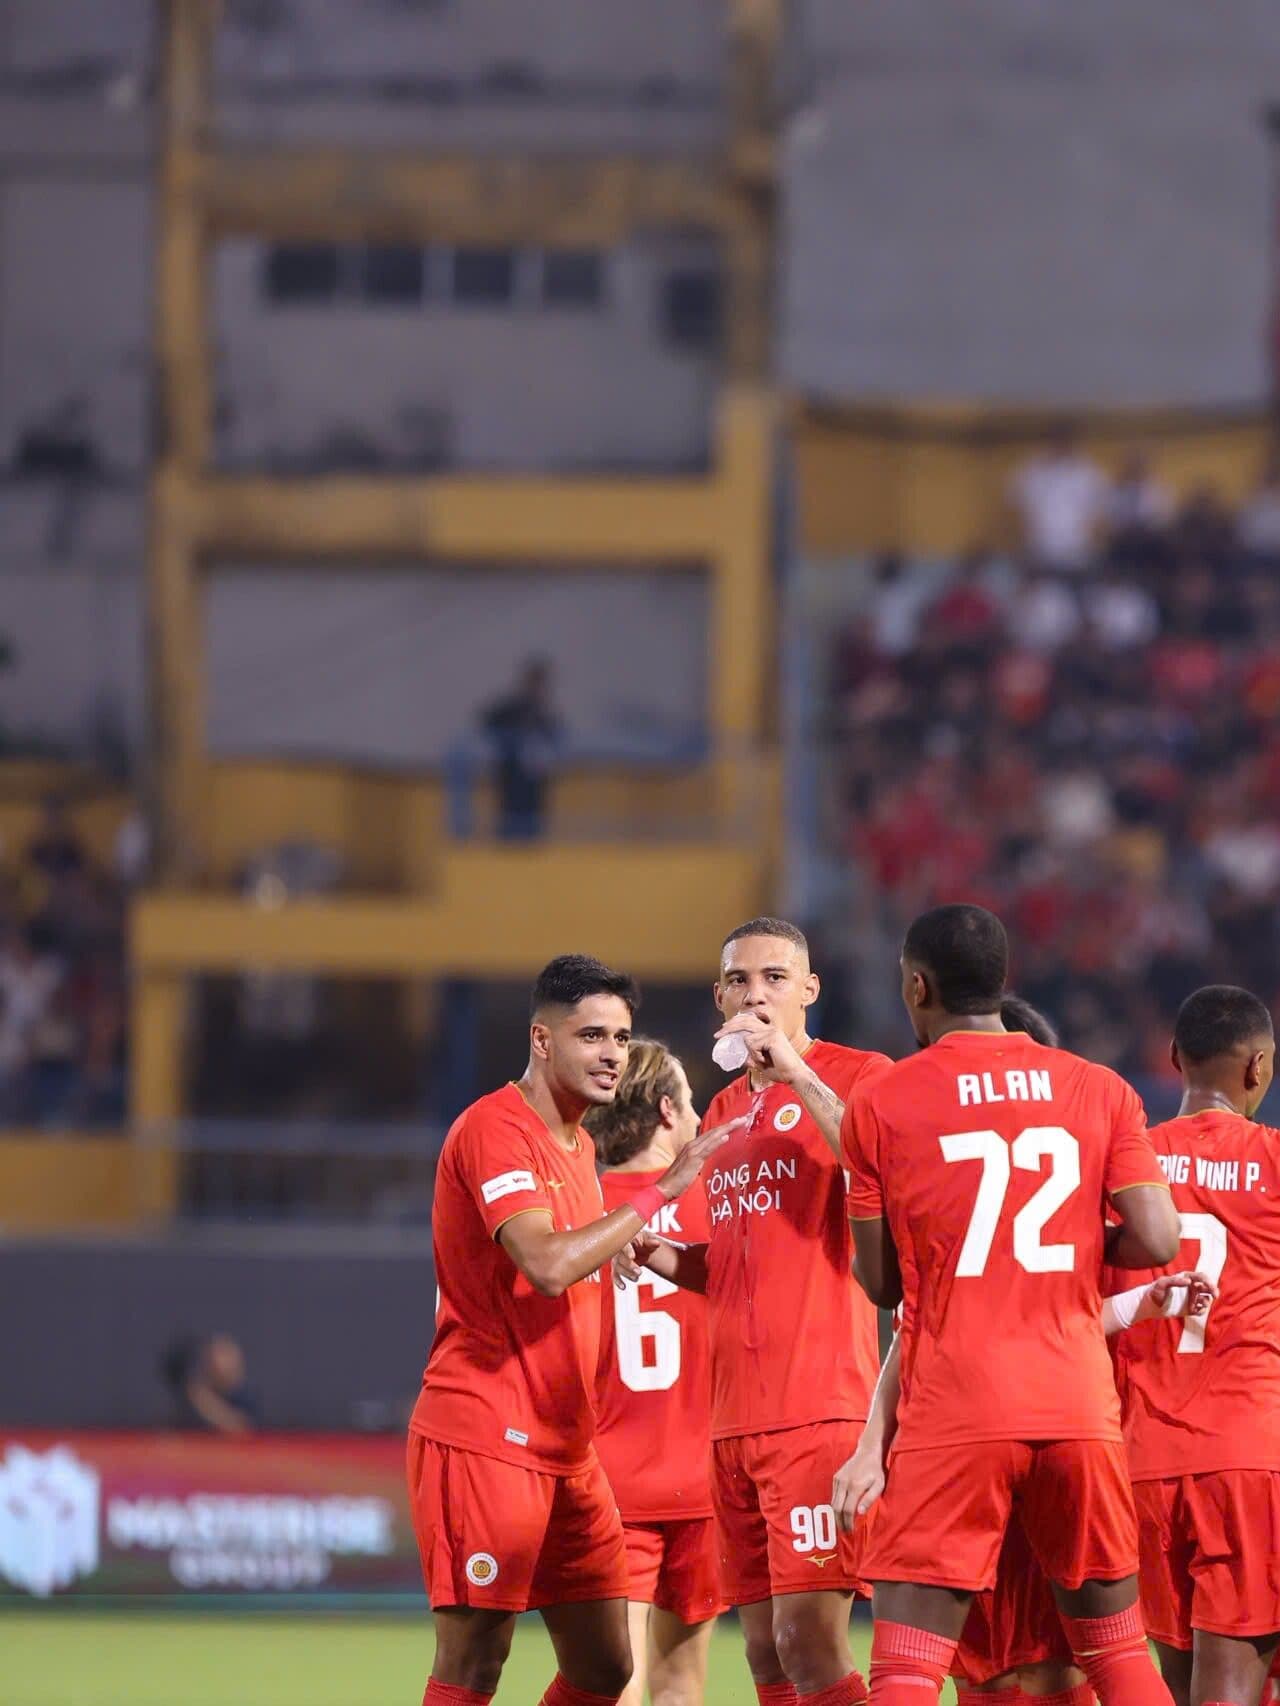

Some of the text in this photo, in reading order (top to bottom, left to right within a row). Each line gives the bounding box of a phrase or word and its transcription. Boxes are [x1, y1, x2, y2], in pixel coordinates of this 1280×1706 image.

[957, 1070, 1053, 1106] ALAN
[756, 1158, 795, 1182] AN
[1196, 1157, 1239, 1191] VINH
[1245, 1161, 1267, 1193] P.
[711, 1185, 780, 1226] HÀ NỘI
[938, 1126, 1081, 1277] 72
[611, 1265, 681, 1392] 6
[790, 1504, 837, 1553] 90
